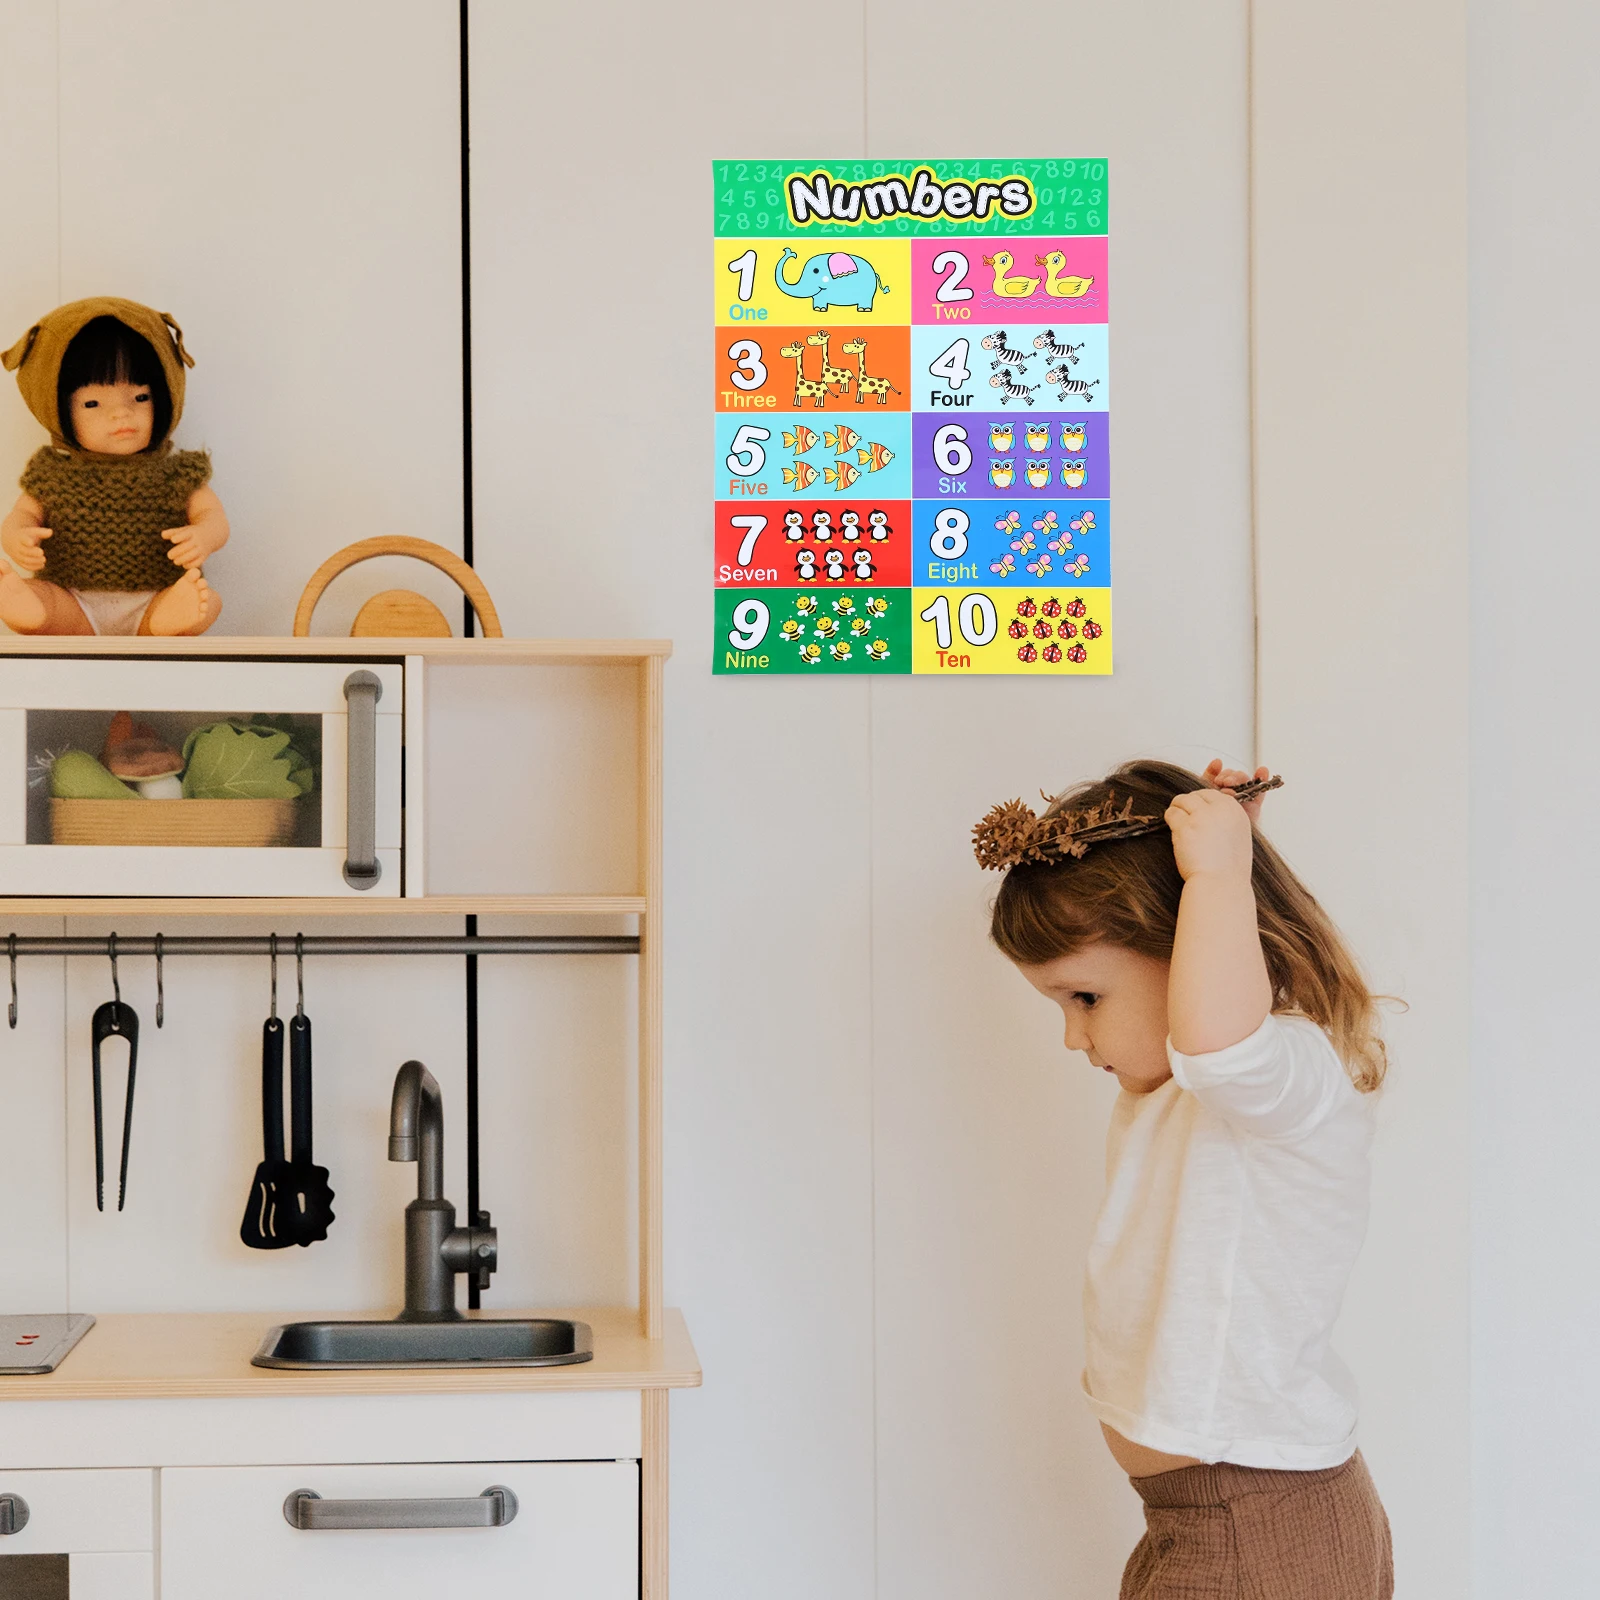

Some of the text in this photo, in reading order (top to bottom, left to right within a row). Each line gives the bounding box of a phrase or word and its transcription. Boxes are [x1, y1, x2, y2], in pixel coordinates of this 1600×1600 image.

[719, 165, 729, 182] 1
[735, 163, 750, 182] 2
[753, 164, 767, 182] 3
[770, 165, 784, 182] 4
[852, 164, 867, 182] 8
[935, 162, 949, 180] 2
[967, 161, 981, 179] 4
[990, 163, 1003, 180] 5
[1029, 163, 1042, 182] 7
[1045, 160, 1060, 178] 8
[1062, 160, 1076, 178] 9
[1080, 162, 1105, 181] 10
[720, 188, 735, 206] 4
[743, 190, 757, 208] 5
[765, 188, 780, 206] 6
[1070, 188, 1085, 206] 2
[1088, 188, 1102, 206] 3
[787, 169, 1033, 222] Numbers
[718, 213, 732, 231] 7
[736, 212, 750, 230] 8
[755, 212, 770, 230] 9
[1041, 210, 1055, 229] 4
[1064, 211, 1078, 230] 5
[1086, 210, 1101, 228] 6
[728, 249, 757, 302] 1
[932, 250, 975, 303] 2
[729, 304, 768, 321] One
[931, 303, 972, 320] Two
[727, 338, 768, 391] 3
[929, 337, 972, 391] 4
[720, 391, 777, 408] Three
[930, 390, 974, 407] Four
[725, 424, 771, 477] 5
[932, 423, 973, 476] 6
[729, 479, 768, 496] Five
[938, 477, 967, 494] Six
[730, 514, 769, 567] 7
[929, 507, 971, 561] 8
[719, 564, 778, 581] Seven
[928, 562, 979, 583] Eight
[727, 598, 771, 651] 9
[920, 592, 998, 649] 10
[725, 651, 770, 669] Nine
[935, 650, 971, 668] Ten
